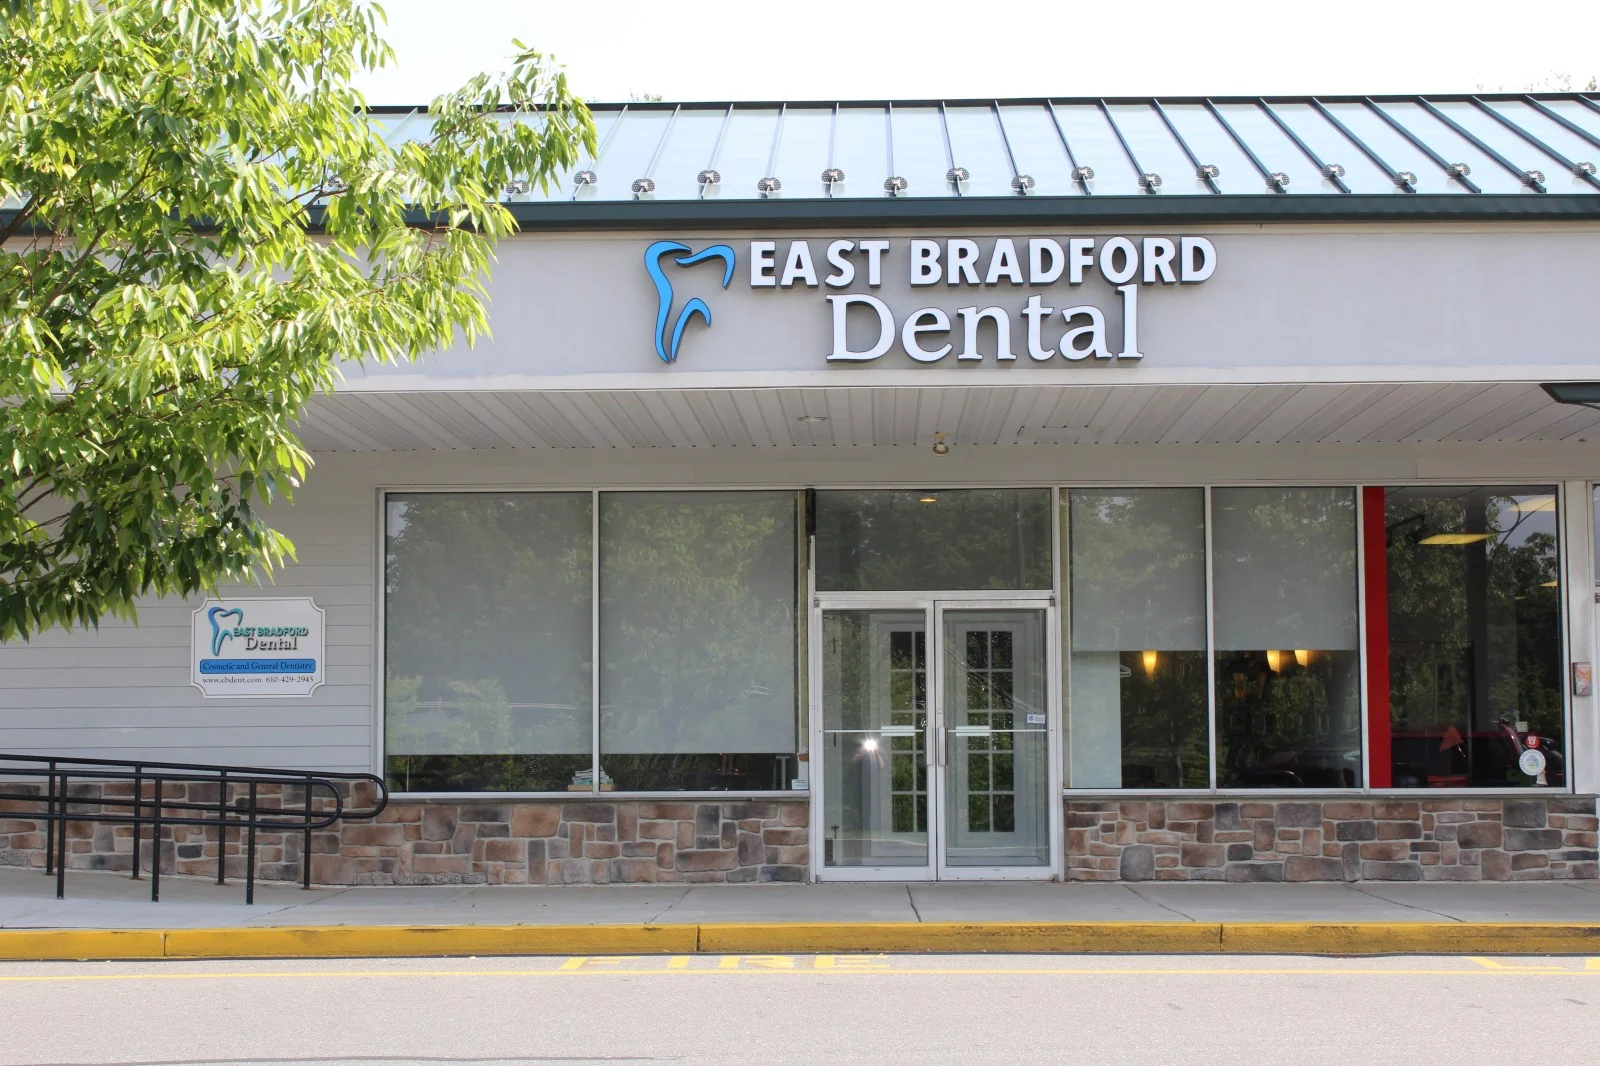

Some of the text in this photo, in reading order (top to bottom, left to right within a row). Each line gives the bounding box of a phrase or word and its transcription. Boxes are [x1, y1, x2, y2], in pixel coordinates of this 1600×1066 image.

[750, 236, 1218, 288] EAST BRADFORD
[826, 284, 1144, 363] Dental
[233, 627, 309, 637] EAST BRADFORD
[245, 637, 298, 651] Dental
[202, 661, 313, 671] Cosmetic and General Dentistry
[266, 675, 314, 683] 610-429-2945
